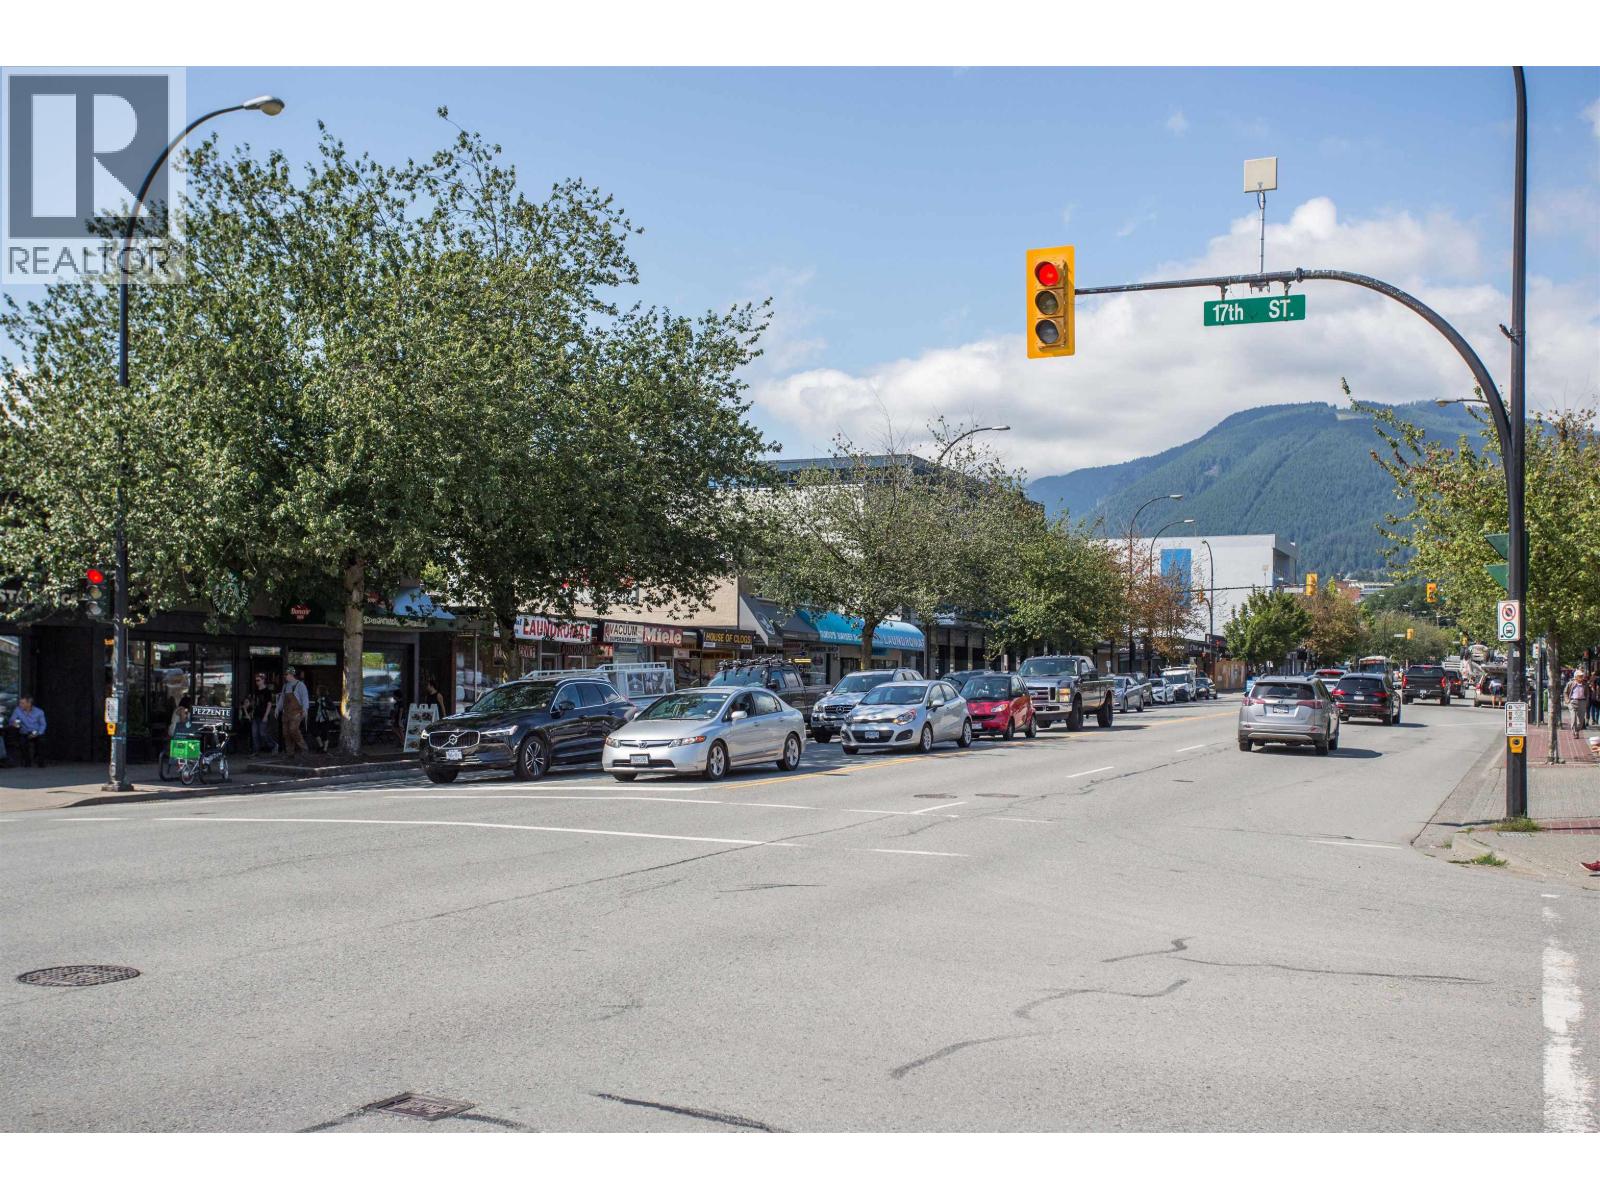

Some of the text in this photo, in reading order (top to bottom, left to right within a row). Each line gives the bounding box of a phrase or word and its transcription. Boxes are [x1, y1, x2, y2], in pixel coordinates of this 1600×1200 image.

[1212, 299, 1295, 322] 17th ST.
[523, 619, 591, 640] LAUNDROMAT
[609, 624, 638, 636] VACUUM
[644, 627, 682, 645] Miele
[706, 631, 752, 644] HOUSE OF CLOGS
[192, 707, 231, 717] PEZZENTE
